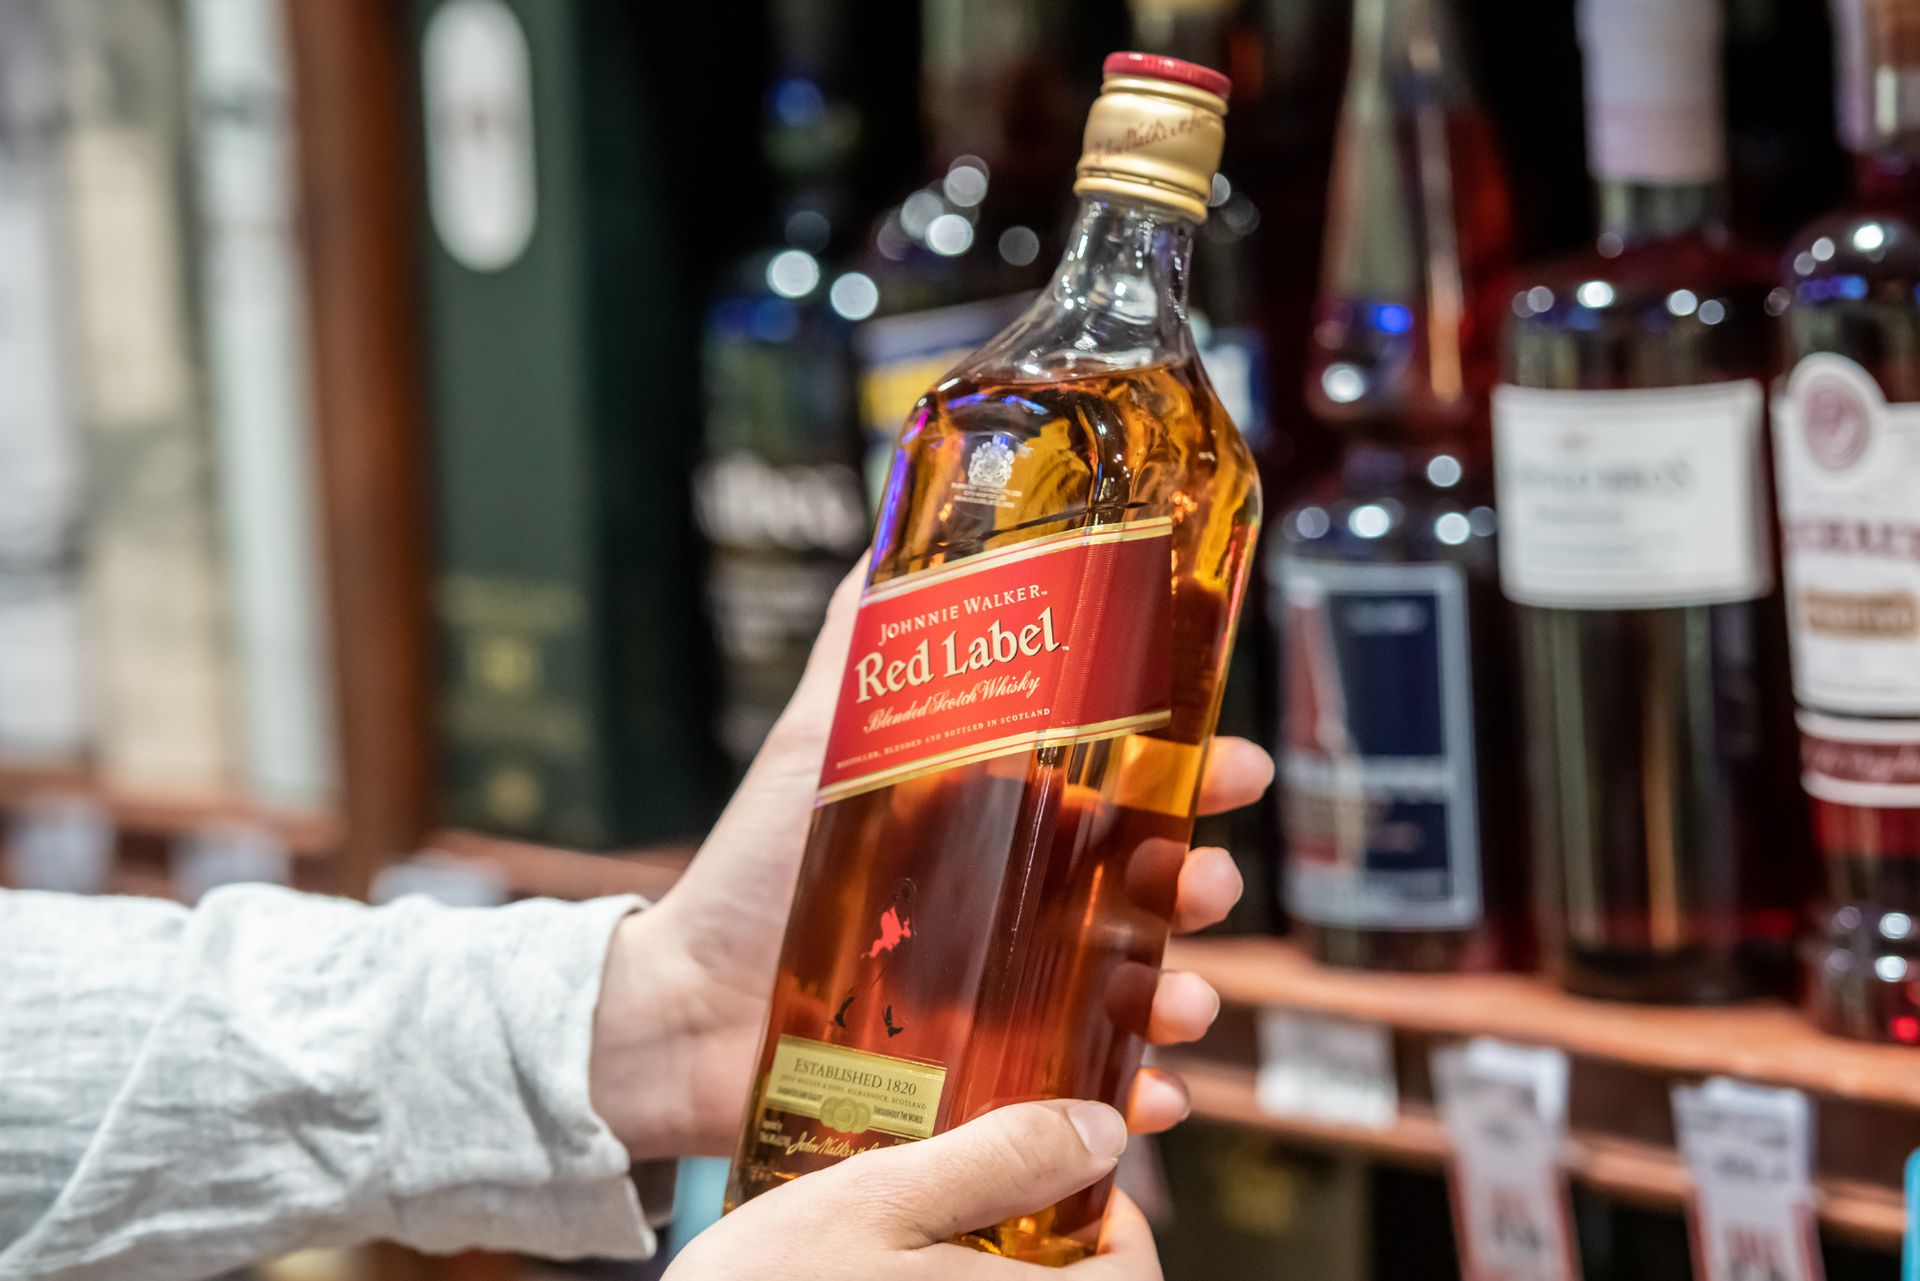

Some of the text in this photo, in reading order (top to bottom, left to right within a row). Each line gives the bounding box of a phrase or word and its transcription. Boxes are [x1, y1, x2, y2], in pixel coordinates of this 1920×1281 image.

[878, 605, 960, 647] JOHNNIE
[855, 606, 1062, 703] Red Label
[863, 670, 1041, 734] Blended Scotch Whisky
[944, 722, 984, 738] BOTTLED
[987, 719, 998, 728] IN
[1000, 708, 1050, 724] SCOTLAND
[794, 1058, 917, 1096] ESTABLISHED 1820
[785, 1131, 818, 1155] John
